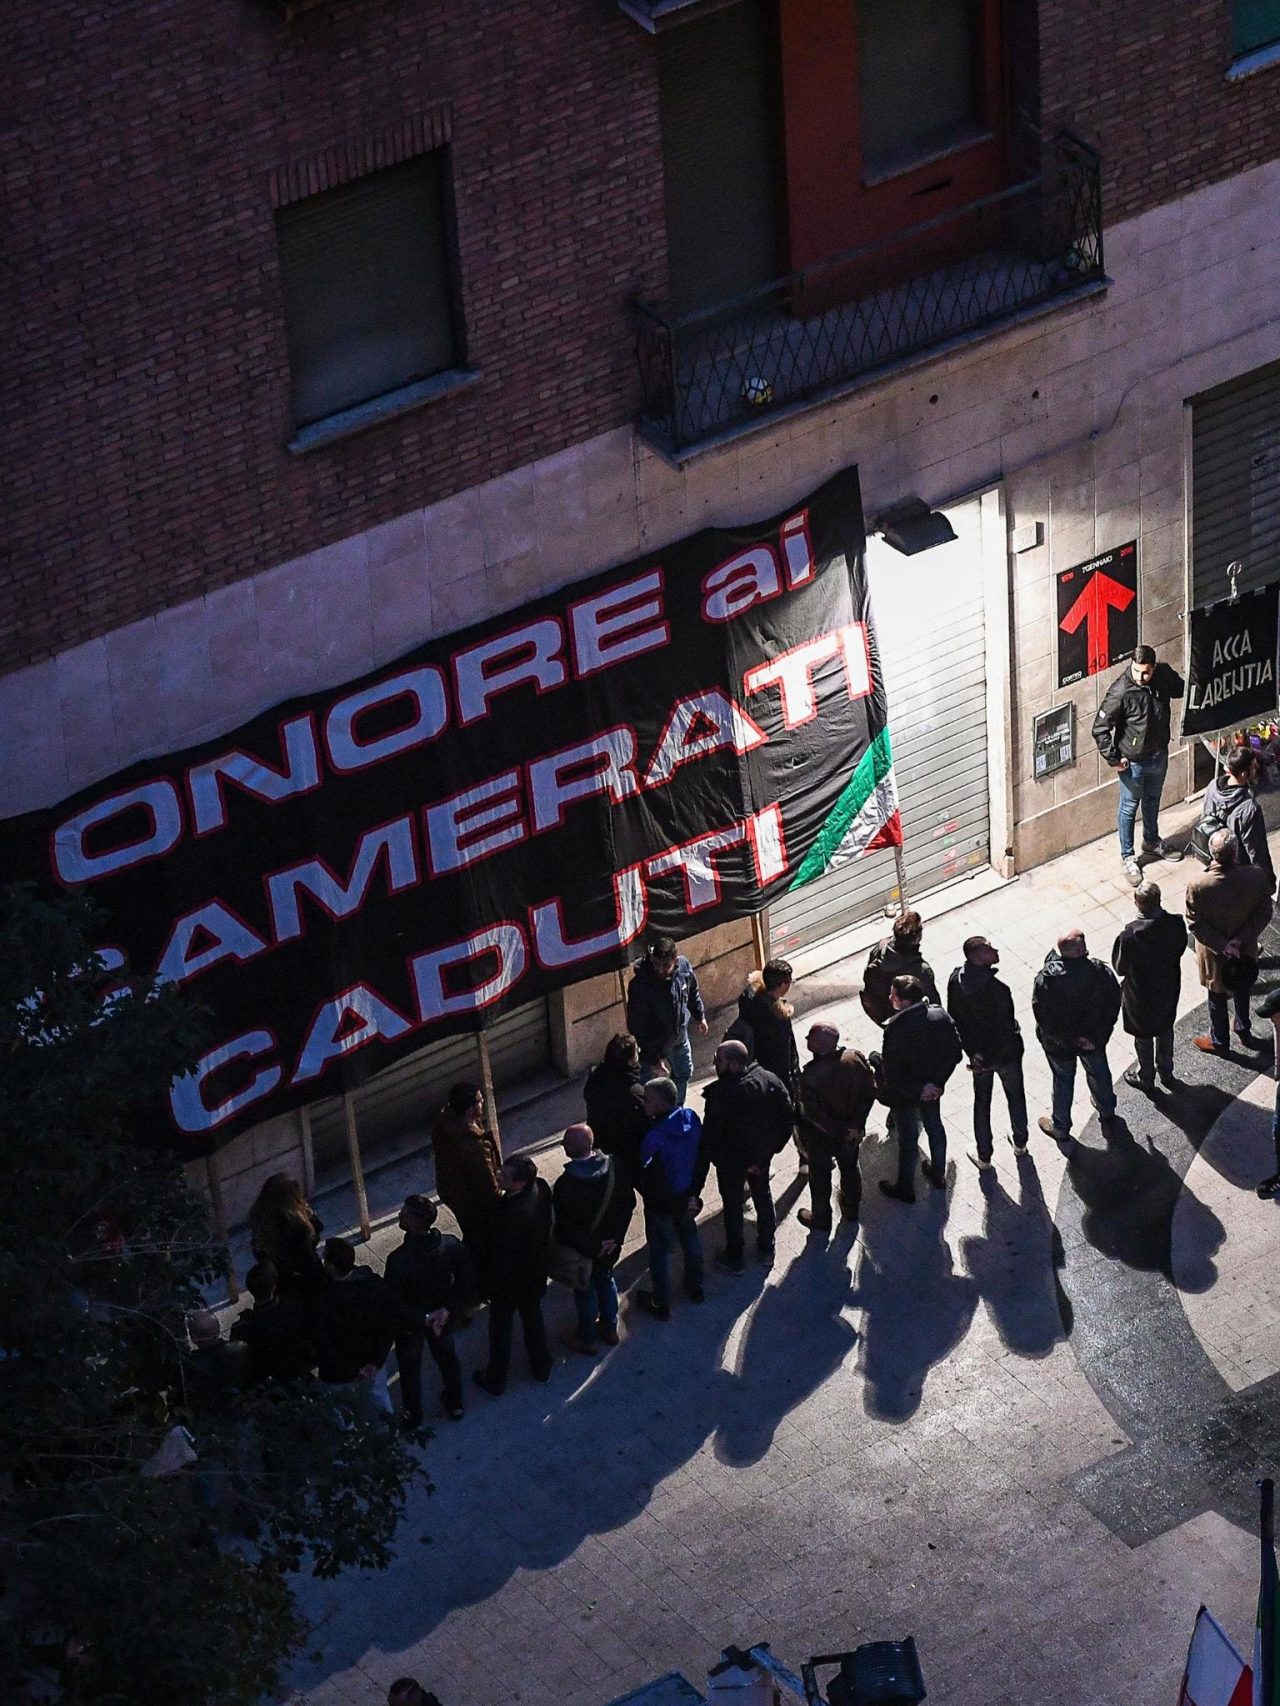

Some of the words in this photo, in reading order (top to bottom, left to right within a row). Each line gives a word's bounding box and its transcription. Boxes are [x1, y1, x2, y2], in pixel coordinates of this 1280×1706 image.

[50, 567, 671, 887] ONORE
[701, 508, 816, 624] ai
[1189, 659, 1273, 710] LARENTIA
[1213, 629, 1252, 668] ACCA
[169, 801, 789, 1134] CADUTI
